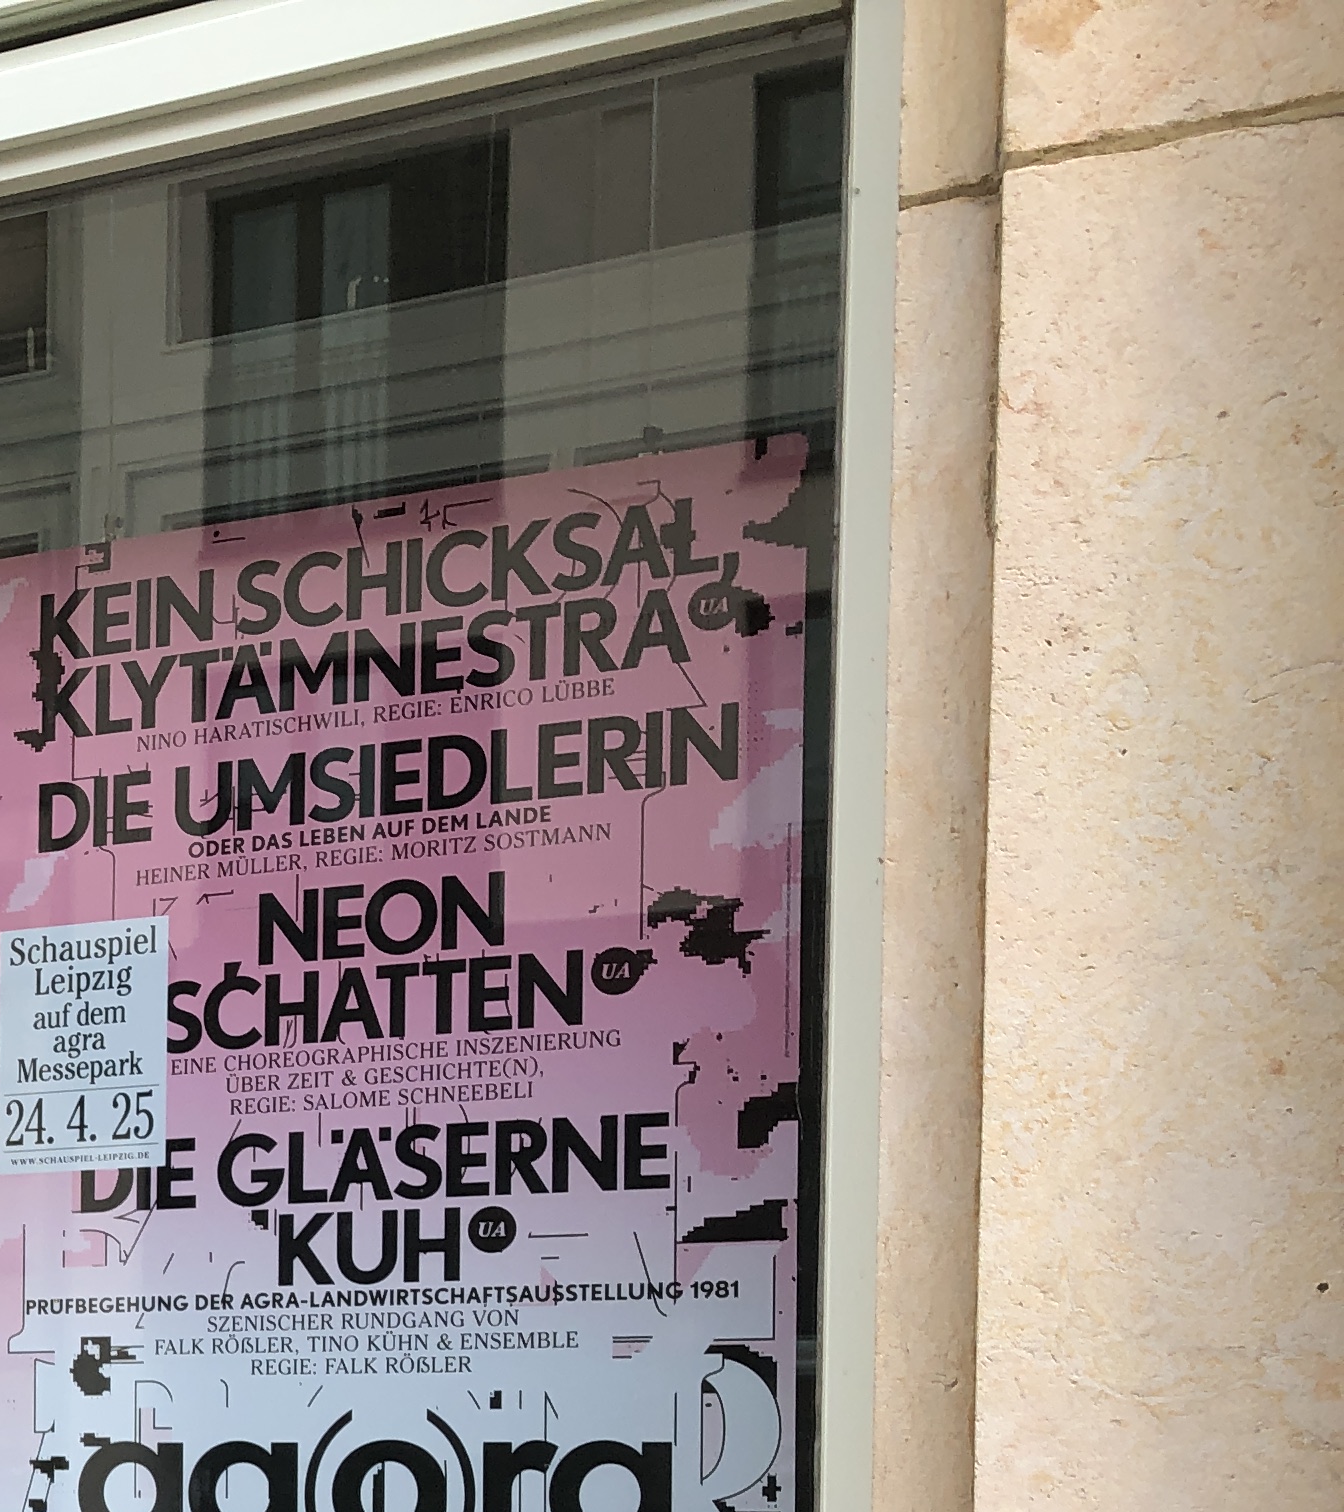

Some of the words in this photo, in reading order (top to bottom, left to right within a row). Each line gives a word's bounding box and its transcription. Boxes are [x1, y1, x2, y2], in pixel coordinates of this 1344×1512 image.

[40, 568, 215, 660] KEIN
[236, 498, 739, 636] SCHICKSAL,
[41, 588, 691, 742] KLYTÄMNESTRA
[136, 729, 187, 752] NINO
[194, 709, 365, 746] HARATISCHWILI,
[373, 700, 442, 724] REGIE:
[450, 688, 533, 714] ENRICO
[541, 677, 615, 703] LÜBBE
[38, 769, 152, 853] DIE
[174, 701, 740, 837] UMSIEDLERIN
[188, 838, 244, 859] ODER
[251, 831, 292, 852] DAS
[299, 824, 365, 848] LEBEN
[372, 818, 415, 840] AUF
[422, 813, 469, 835] DEM
[476, 805, 552, 830] LANDE
[135, 864, 210, 887] HEINER
[217, 852, 308, 878] MÜLLER,
[315, 846, 384, 869] REGIE:
[391, 835, 477, 861] MORITZ
[483, 823, 612, 853] SOSTMANN
[258, 871, 506, 966] NEON
[9, 925, 157, 966] Schauspiel
[34, 965, 132, 1000] Leipzig
[167, 949, 584, 1054] SCHATTEN
[601, 962, 631, 979] UA
[32, 1003, 72, 1030] auf
[76, 1001, 127, 1026] dem
[53, 1031, 106, 1058] agra
[170, 1056, 216, 1077] EINE
[223, 1040, 448, 1073] CHOREOGRAPHISCHE
[456, 1029, 622, 1059] INSZENIERUNG
[16, 1050, 143, 1084] Messepark
[225, 1072, 281, 1095] ÜBER
[287, 1070, 335, 1090] ZEIT
[341, 1069, 358, 1087] &
[364, 1056, 545, 1086] GESCHICHTE(N),
[5, 1098, 55, 1147] 24.
[66, 1094, 97, 1143] 4.
[111, 1089, 155, 1141] 25
[229, 1096, 297, 1116] REGIE:
[303, 1090, 391, 1111] SALOME
[397, 1081, 534, 1106] SCHNEEBELI
[10, 1151, 150, 1167] WWW.SCHAUSPIEL-LEIPZIG.DE
[80, 1138, 196, 1214] DIE
[217, 1112, 671, 1207] GLÄSERNE
[278, 1207, 461, 1286] KUH
[477, 1220, 507, 1238] UA
[25, 1294, 189, 1315] PRÜFBEGEHUNG
[194, 1293, 235, 1311] DER
[240, 1282, 684, 1310] AGRA-LANDWIRTSCHAFTSAUSSTELLUNG
[690, 1279, 740, 1300] 1981
[154, 1337, 205, 1356] FALK
[306, 1334, 359, 1354] TINO
[366, 1328, 429, 1352] KÜHN
[436, 1333, 452, 1350] &
[461, 1330, 579, 1350] ENSEMBLE
[206, 1312, 333, 1333] SZENISCHER
[341, 1309, 465, 1331] RUNDGANG
[473, 1308, 519, 1328] VON
[250, 1357, 317, 1376] REGIE:
[325, 1356, 377, 1375] FALK
